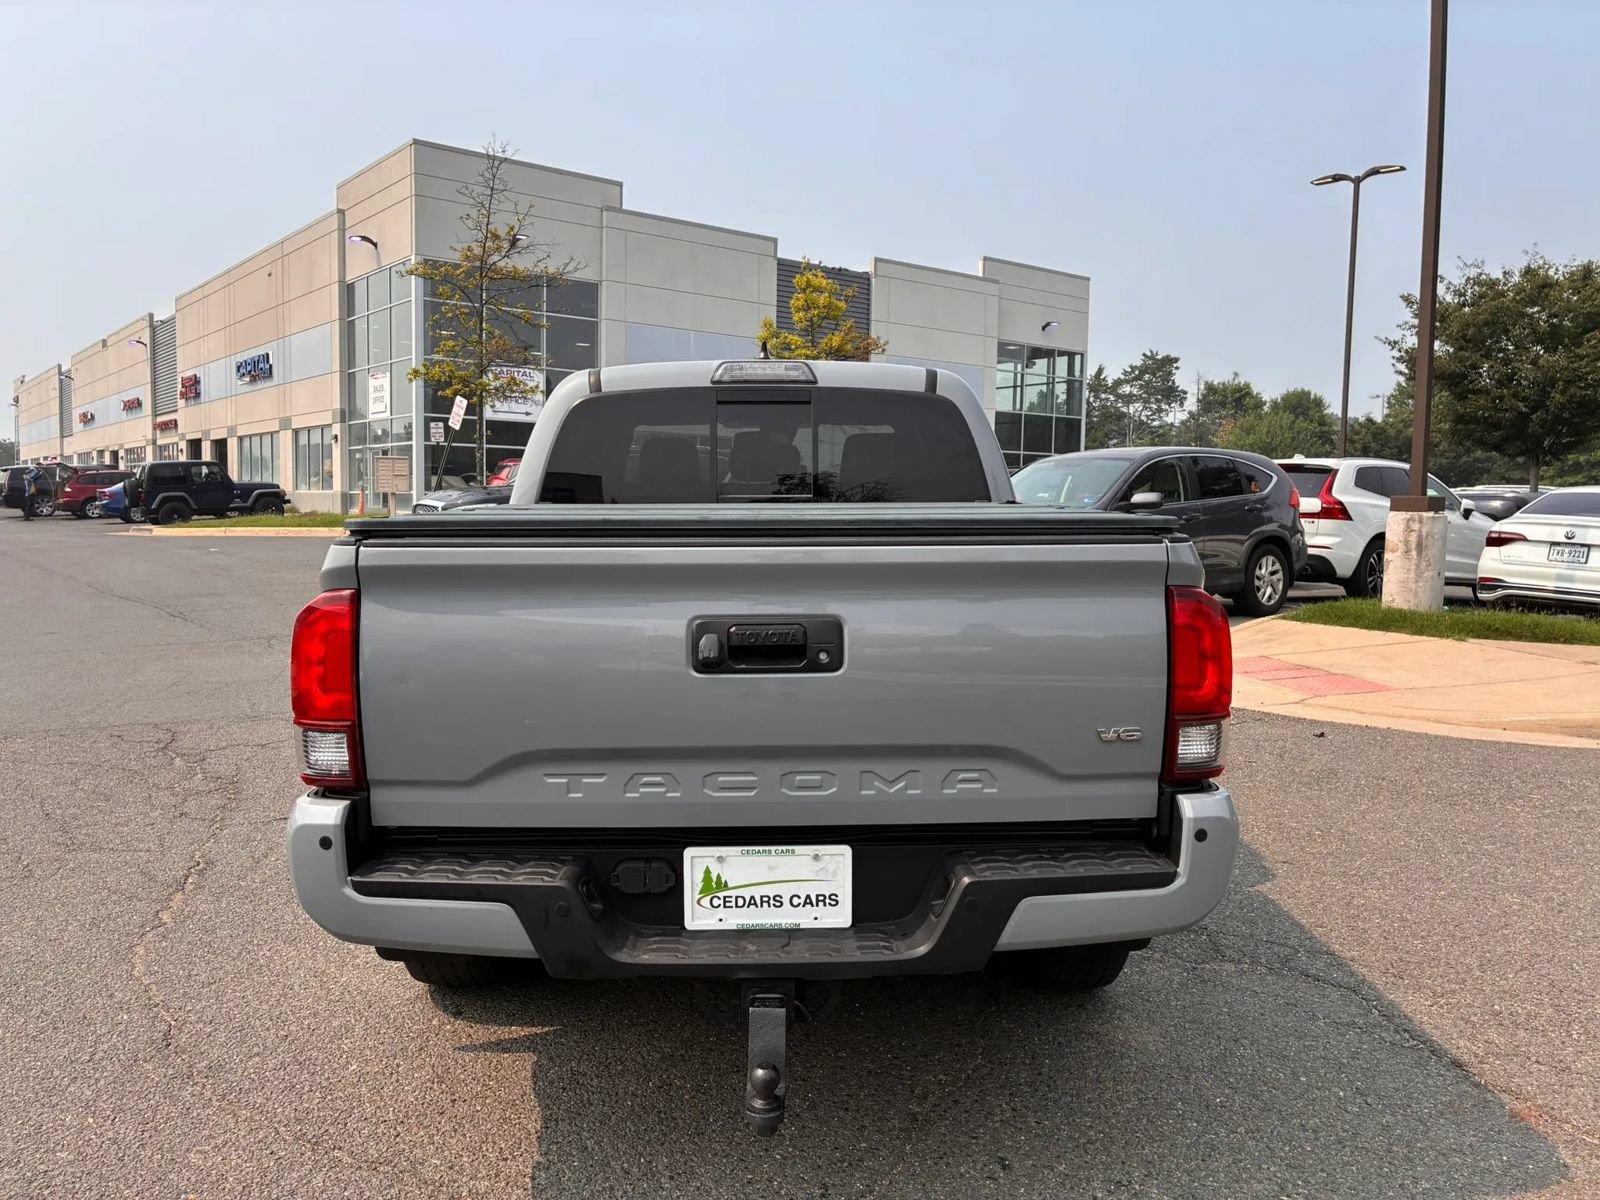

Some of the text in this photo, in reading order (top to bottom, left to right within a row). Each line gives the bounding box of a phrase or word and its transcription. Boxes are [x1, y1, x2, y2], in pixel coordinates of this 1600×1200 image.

[236, 353, 270, 377] CAPITAL
[494, 367, 535, 378] APITAL
[735, 630, 800, 644] TOYOTA
[1096, 726, 1142, 742] V6
[543, 769, 998, 798] TACOMA
[709, 893, 840, 909] CEDARS CARS
